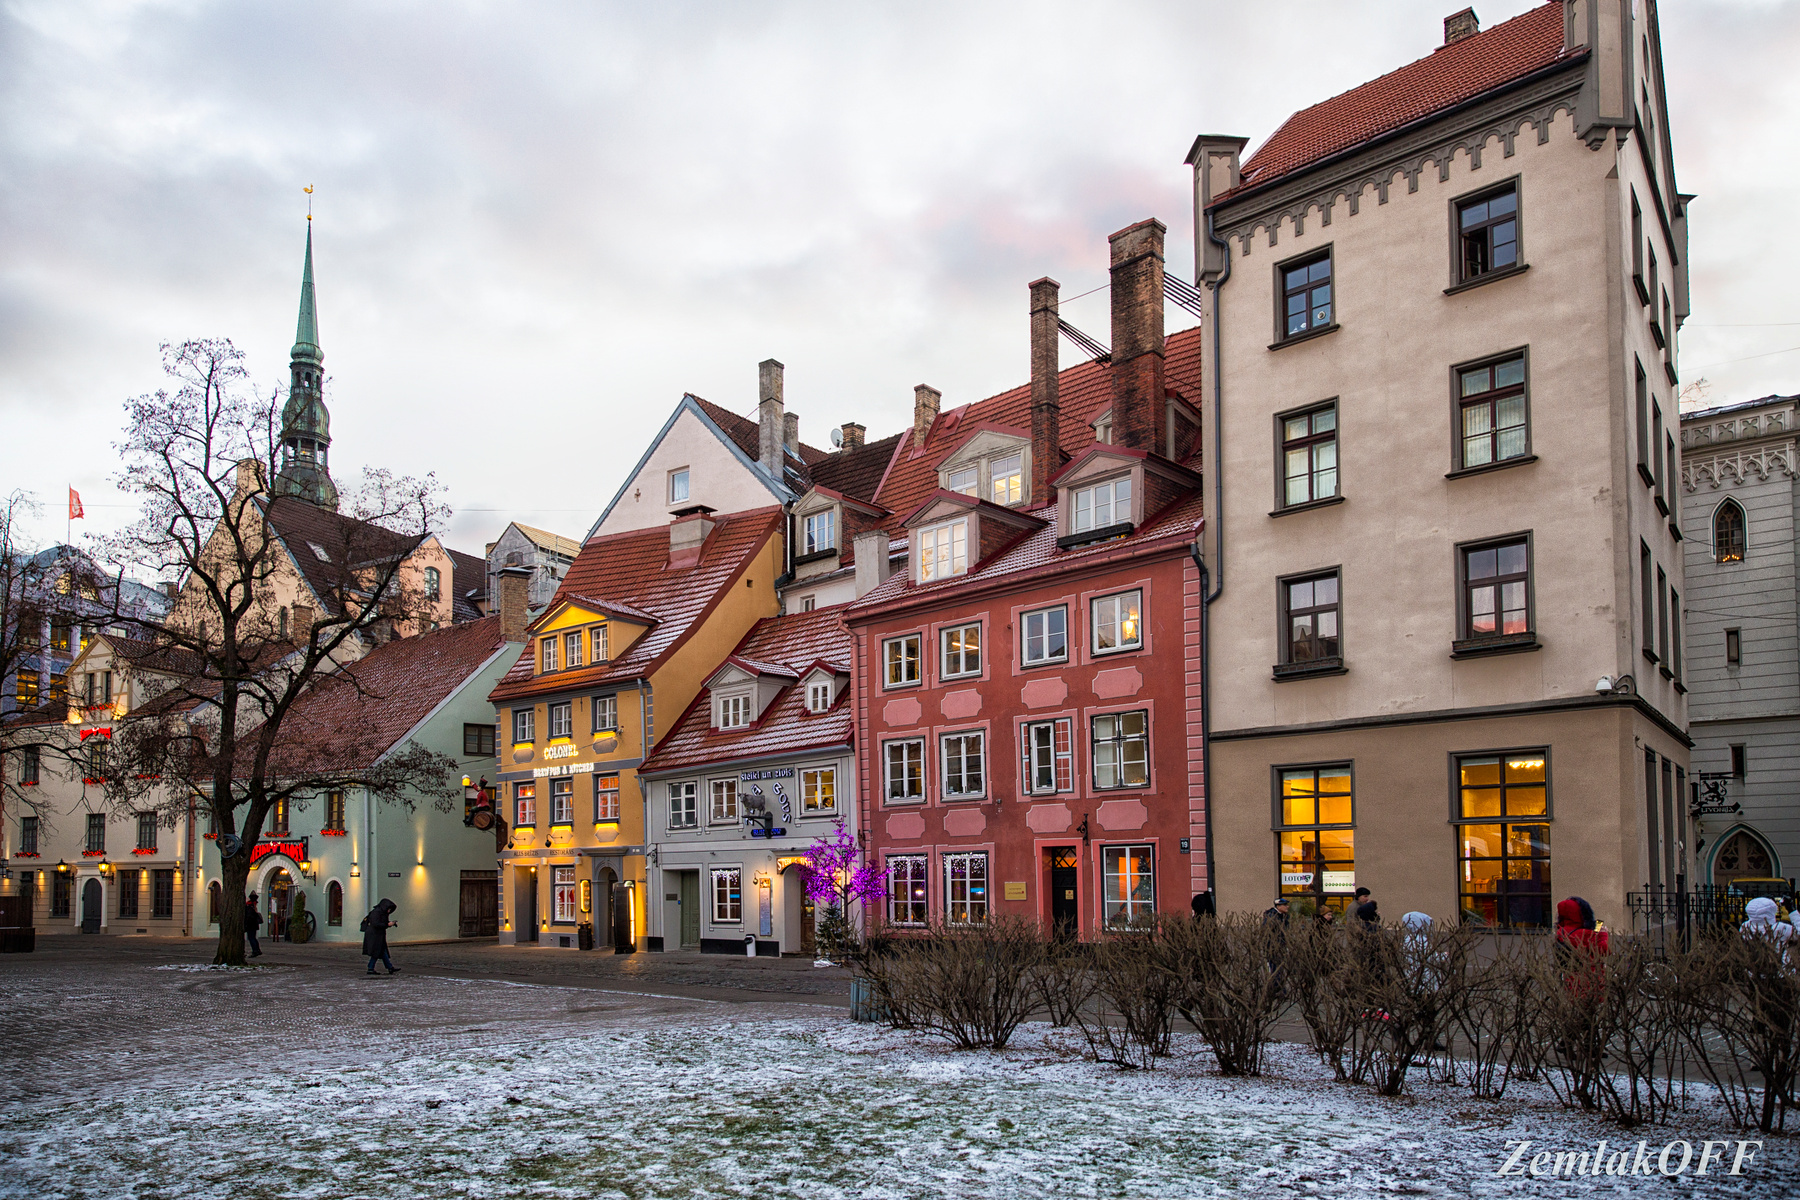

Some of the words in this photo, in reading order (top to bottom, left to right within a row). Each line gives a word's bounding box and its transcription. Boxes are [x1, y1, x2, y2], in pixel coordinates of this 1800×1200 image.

[544, 744, 579, 760] COLONEL
[562, 764, 568, 775] &
[569, 762, 594, 774] KITCHEN
